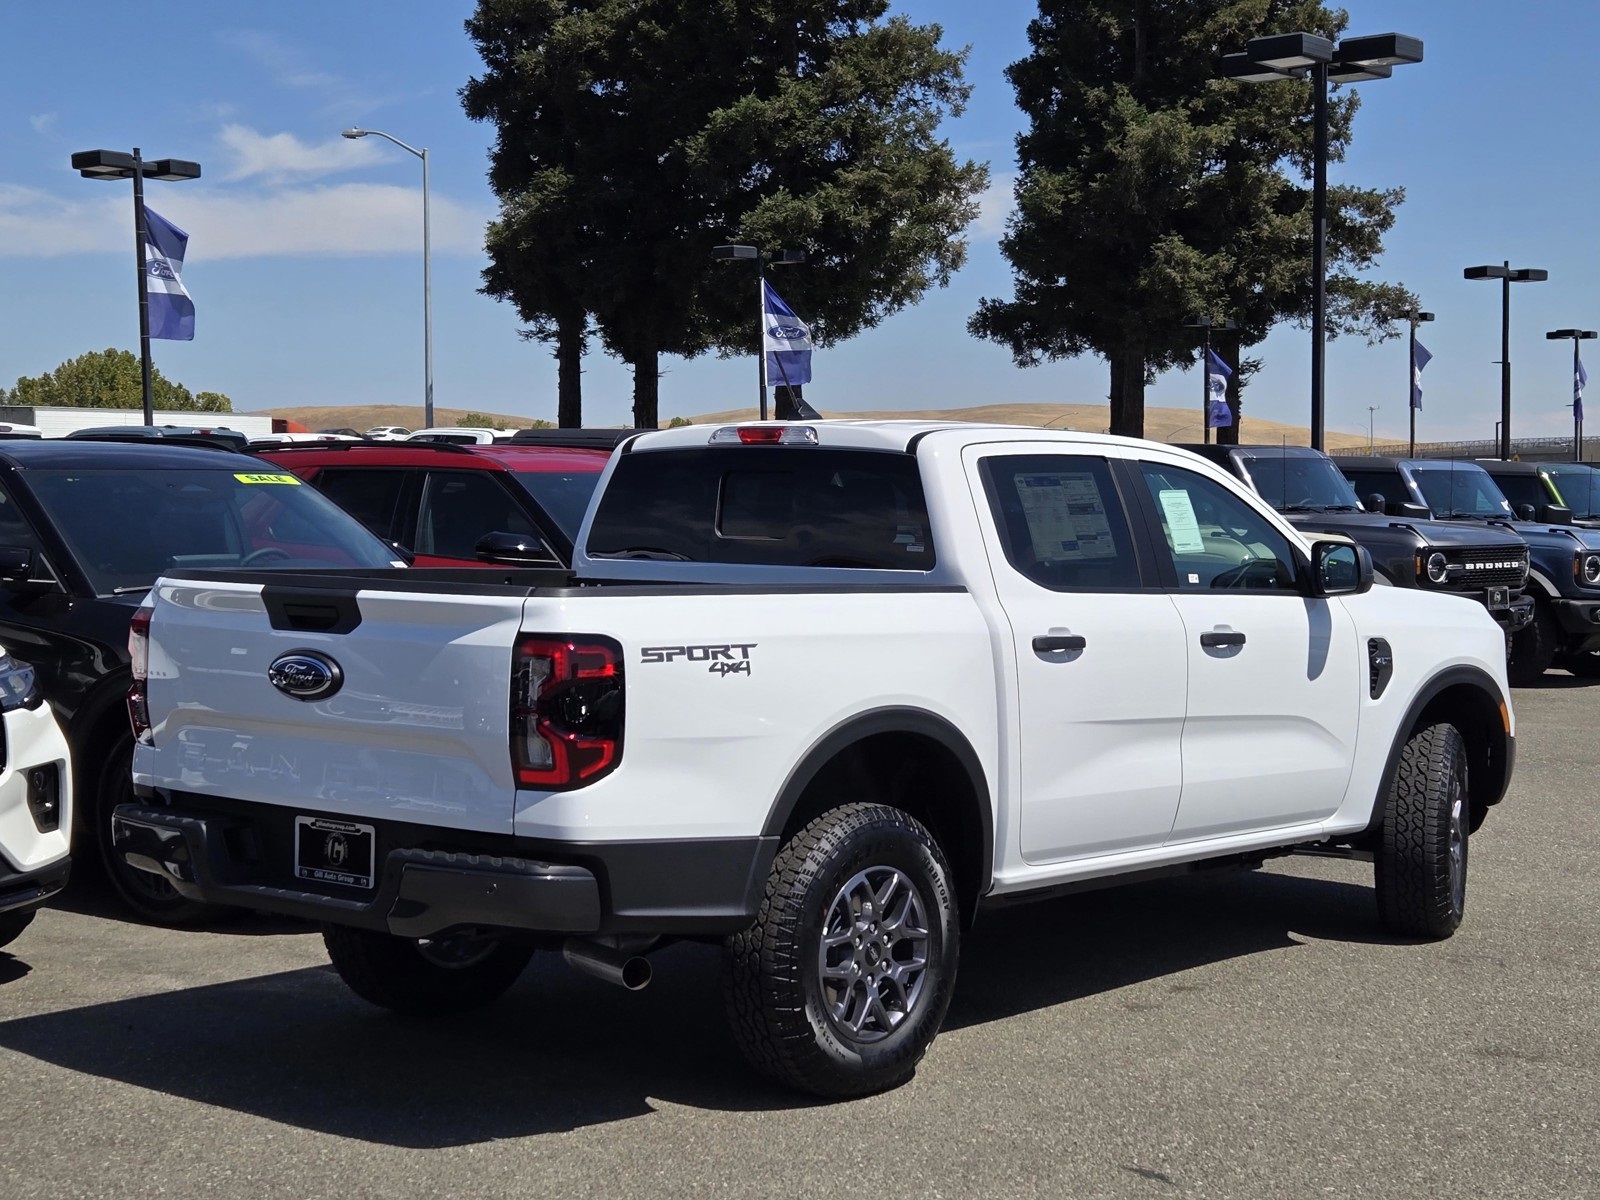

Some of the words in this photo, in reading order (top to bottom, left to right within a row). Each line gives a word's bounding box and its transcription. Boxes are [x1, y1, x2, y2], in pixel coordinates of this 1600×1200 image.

[245, 475, 288, 483] SALE
[1465, 561, 1519, 570] BRONCO
[640, 643, 759, 664] SPORT
